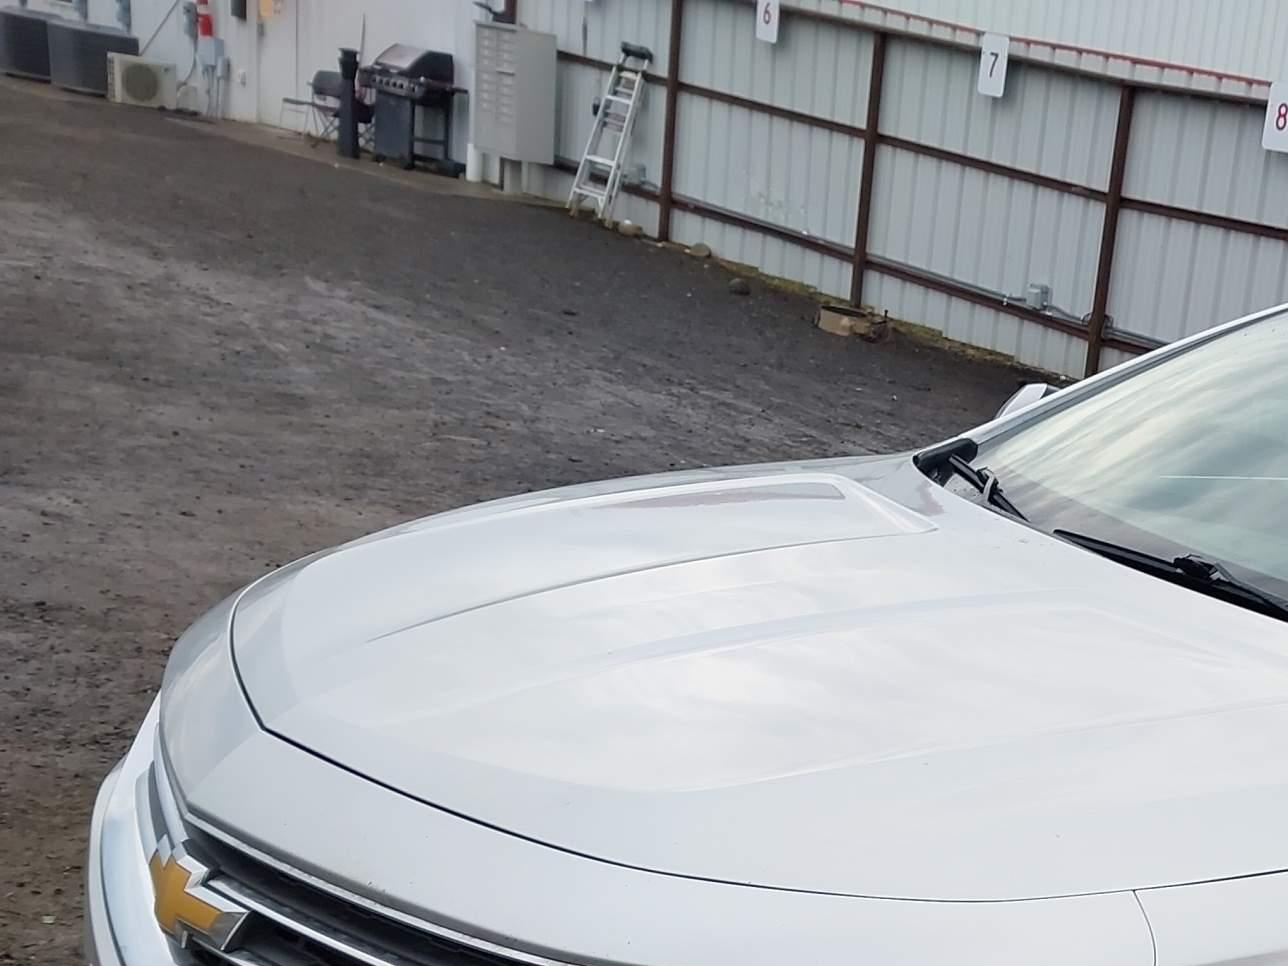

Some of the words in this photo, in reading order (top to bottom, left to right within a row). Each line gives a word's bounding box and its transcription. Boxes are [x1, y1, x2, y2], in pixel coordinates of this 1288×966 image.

[763, 2, 771, 25] 6
[989, 51, 999, 78] 7
[1276, 103, 1288, 131] 8
